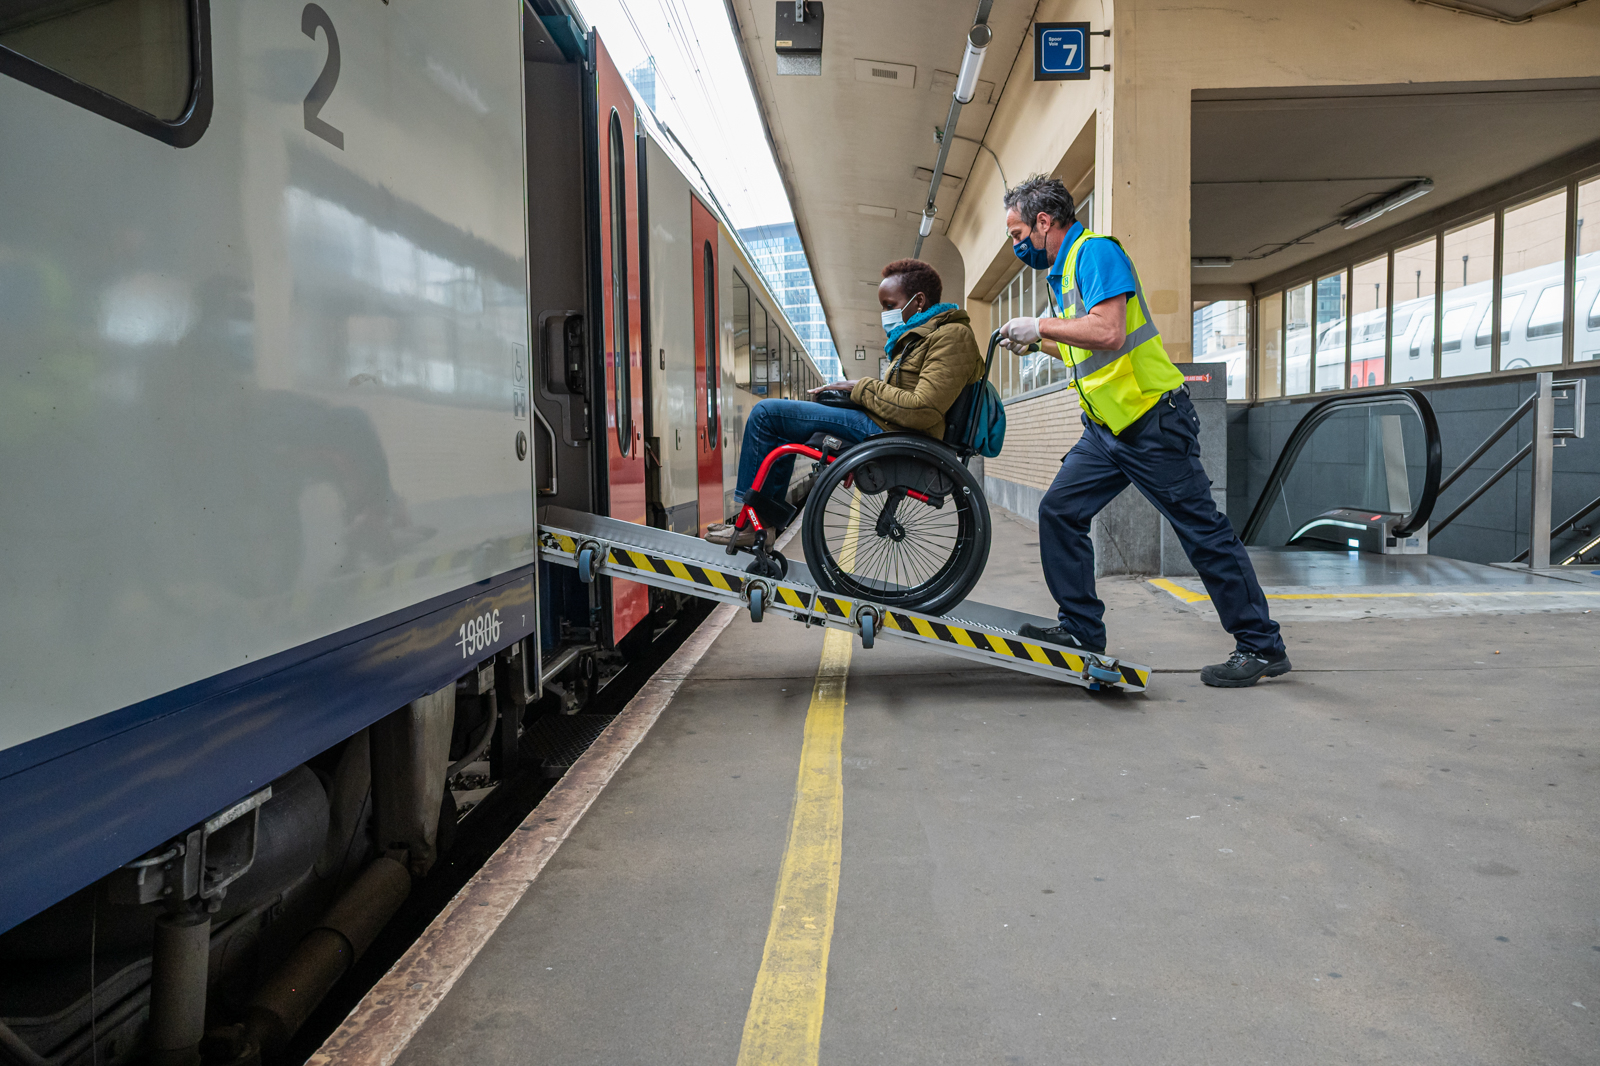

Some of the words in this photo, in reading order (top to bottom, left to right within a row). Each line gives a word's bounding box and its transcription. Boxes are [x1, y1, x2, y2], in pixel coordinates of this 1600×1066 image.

[301, 2, 344, 151] 2
[1062, 44, 1078, 66] 7
[459, 608, 500, 659] 19806
